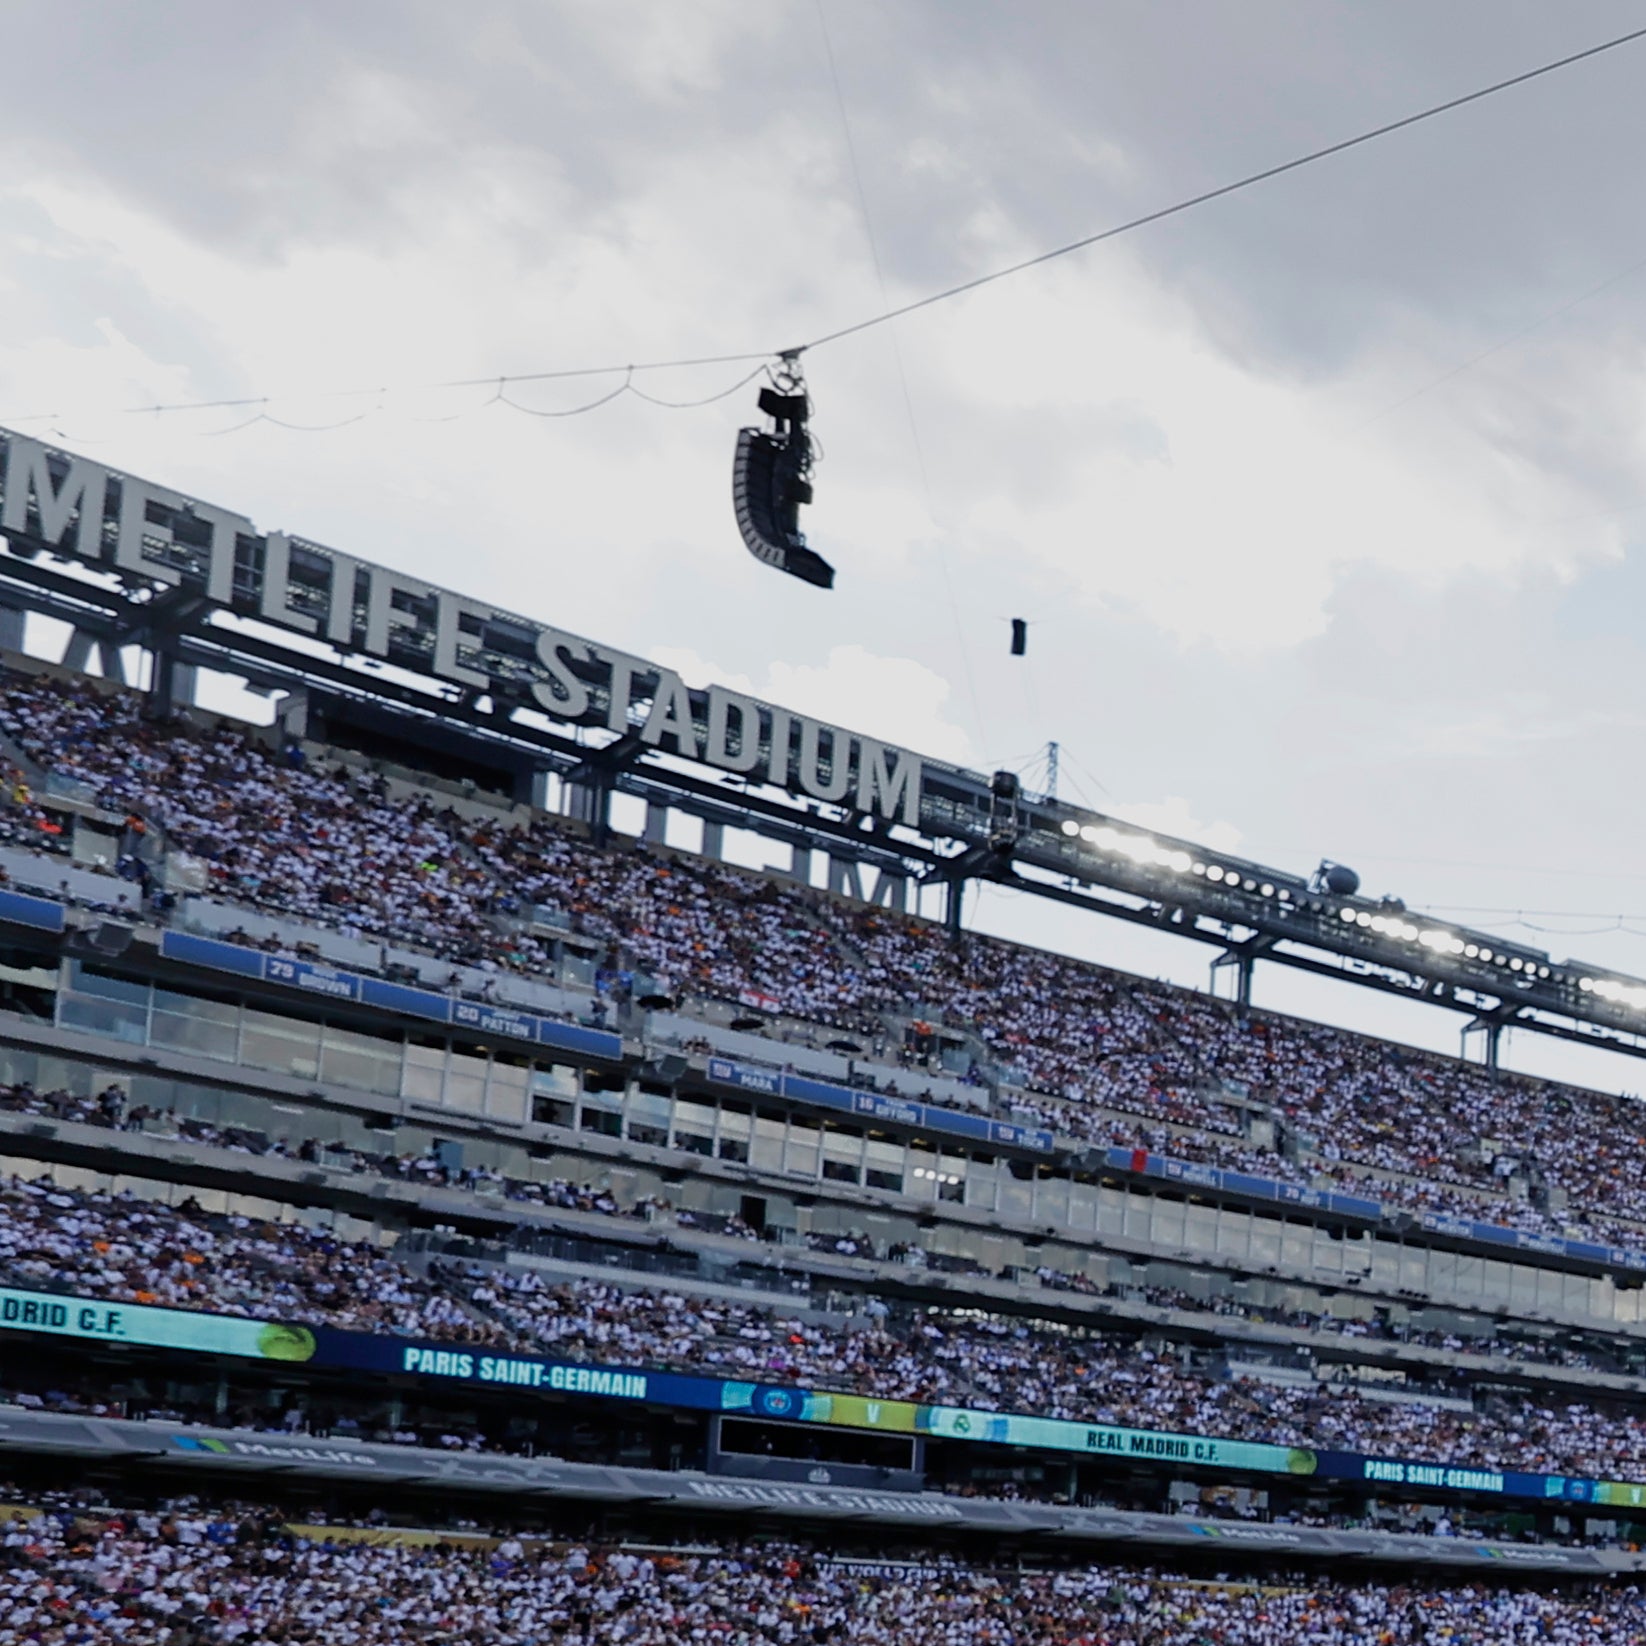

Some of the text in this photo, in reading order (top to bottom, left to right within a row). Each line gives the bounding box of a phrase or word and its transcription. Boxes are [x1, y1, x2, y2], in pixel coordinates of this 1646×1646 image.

[2, 437, 924, 827] METLIFE STADIUM
[79, 1309, 126, 1336] C.F.
[404, 1346, 647, 1399] PARIS SAINT-GERMAIN
[1087, 1429, 1220, 1463] REAL MADRID C.F.
[1364, 1461, 1504, 1493] PARIS SAINT-GERMAIN
